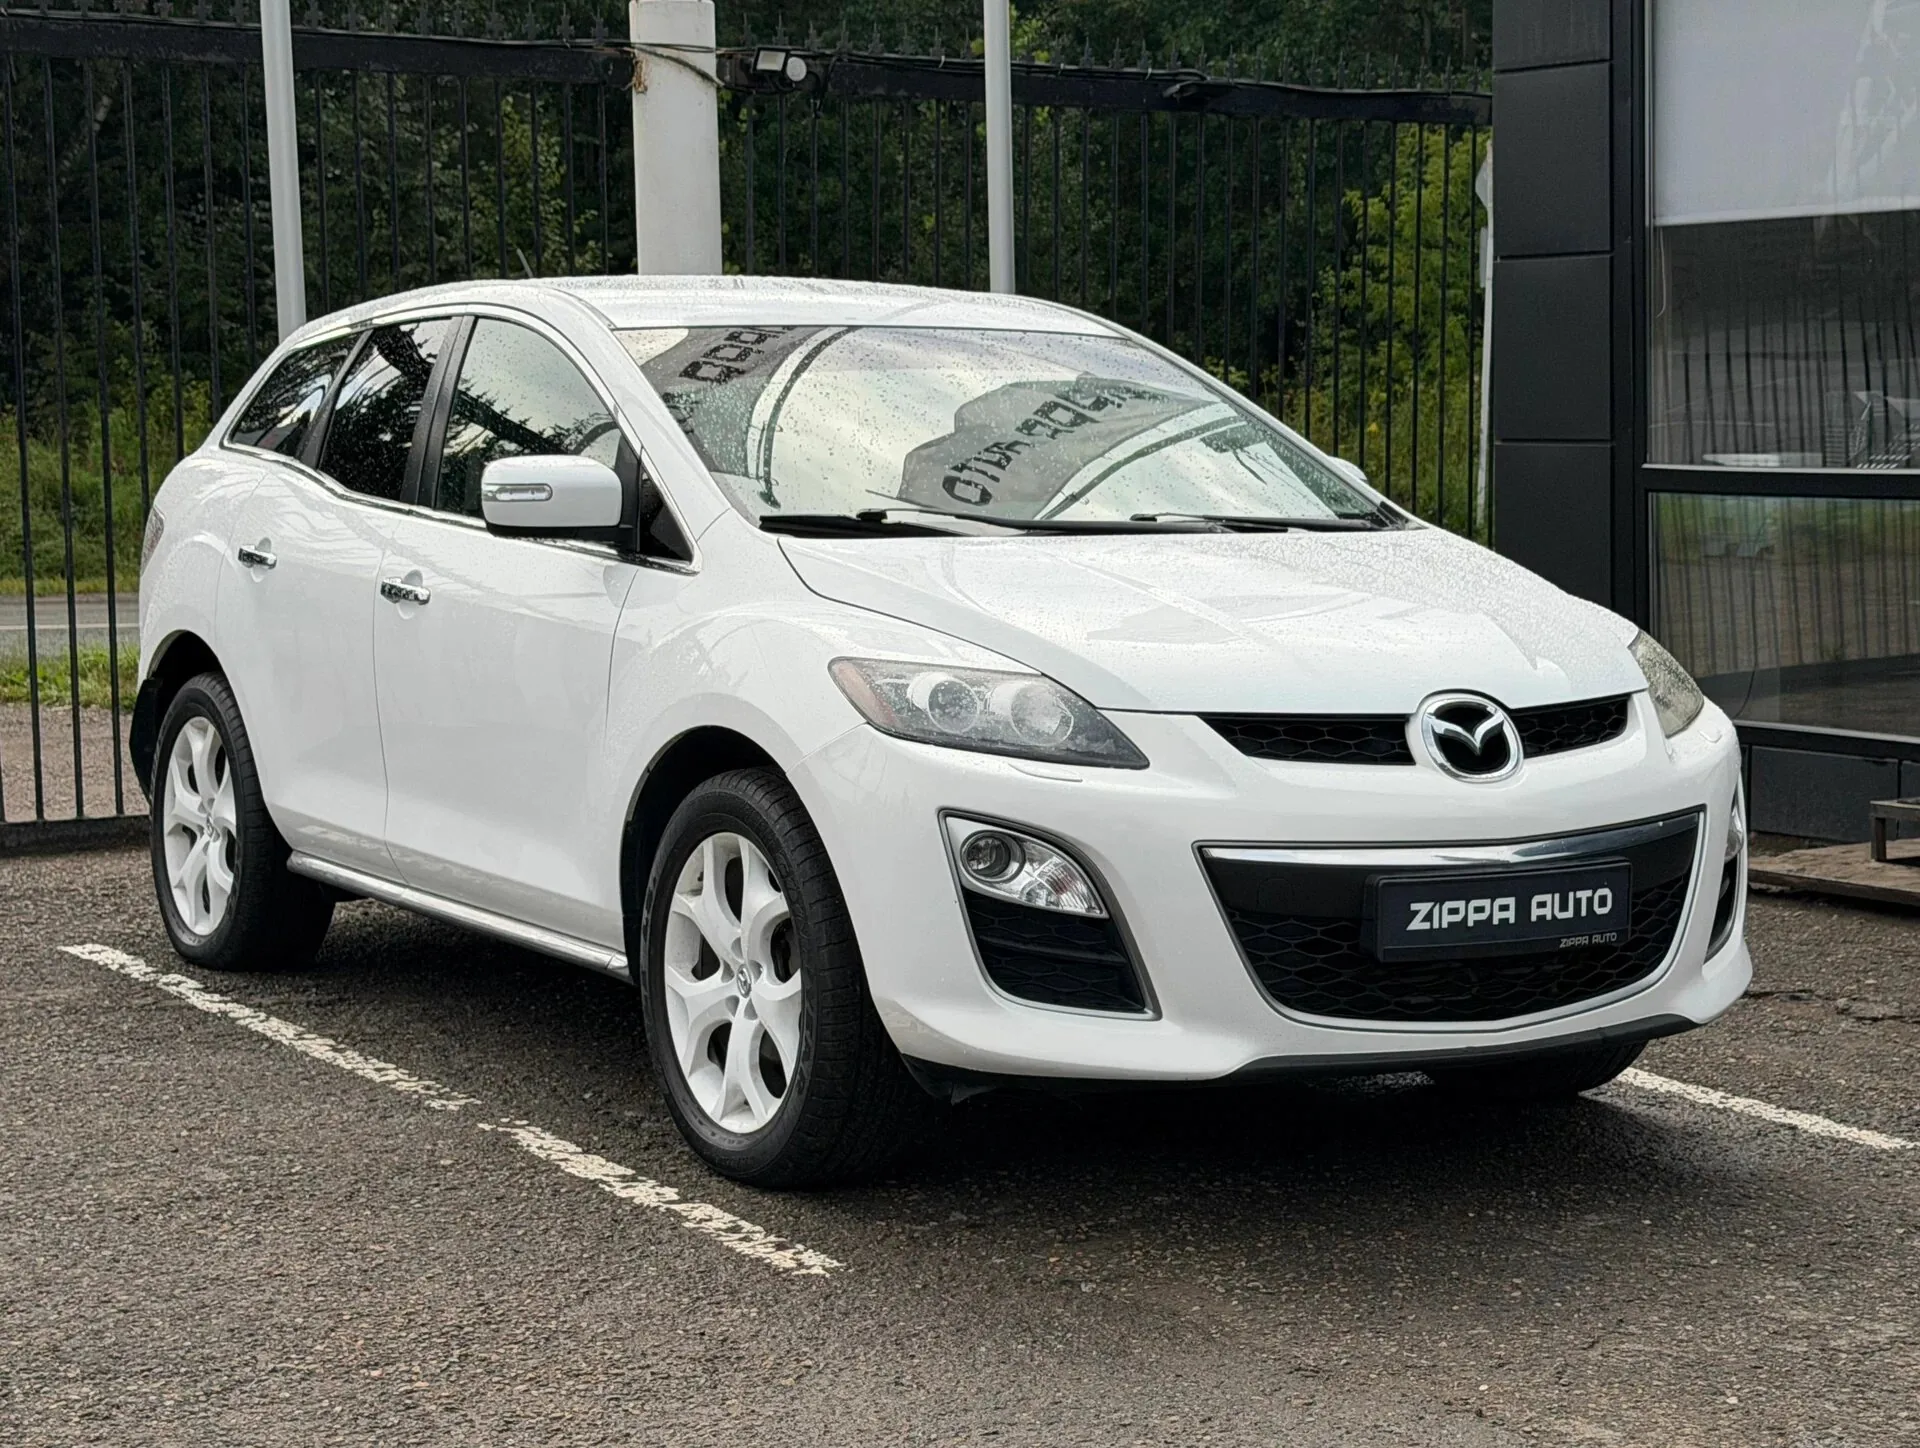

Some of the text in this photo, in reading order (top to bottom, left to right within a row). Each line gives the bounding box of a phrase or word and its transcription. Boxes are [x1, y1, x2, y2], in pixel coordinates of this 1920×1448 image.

[1406, 888, 1613, 931] ZIPPA AUTO
[1559, 931, 1618, 948] ZIPPA AUTO
